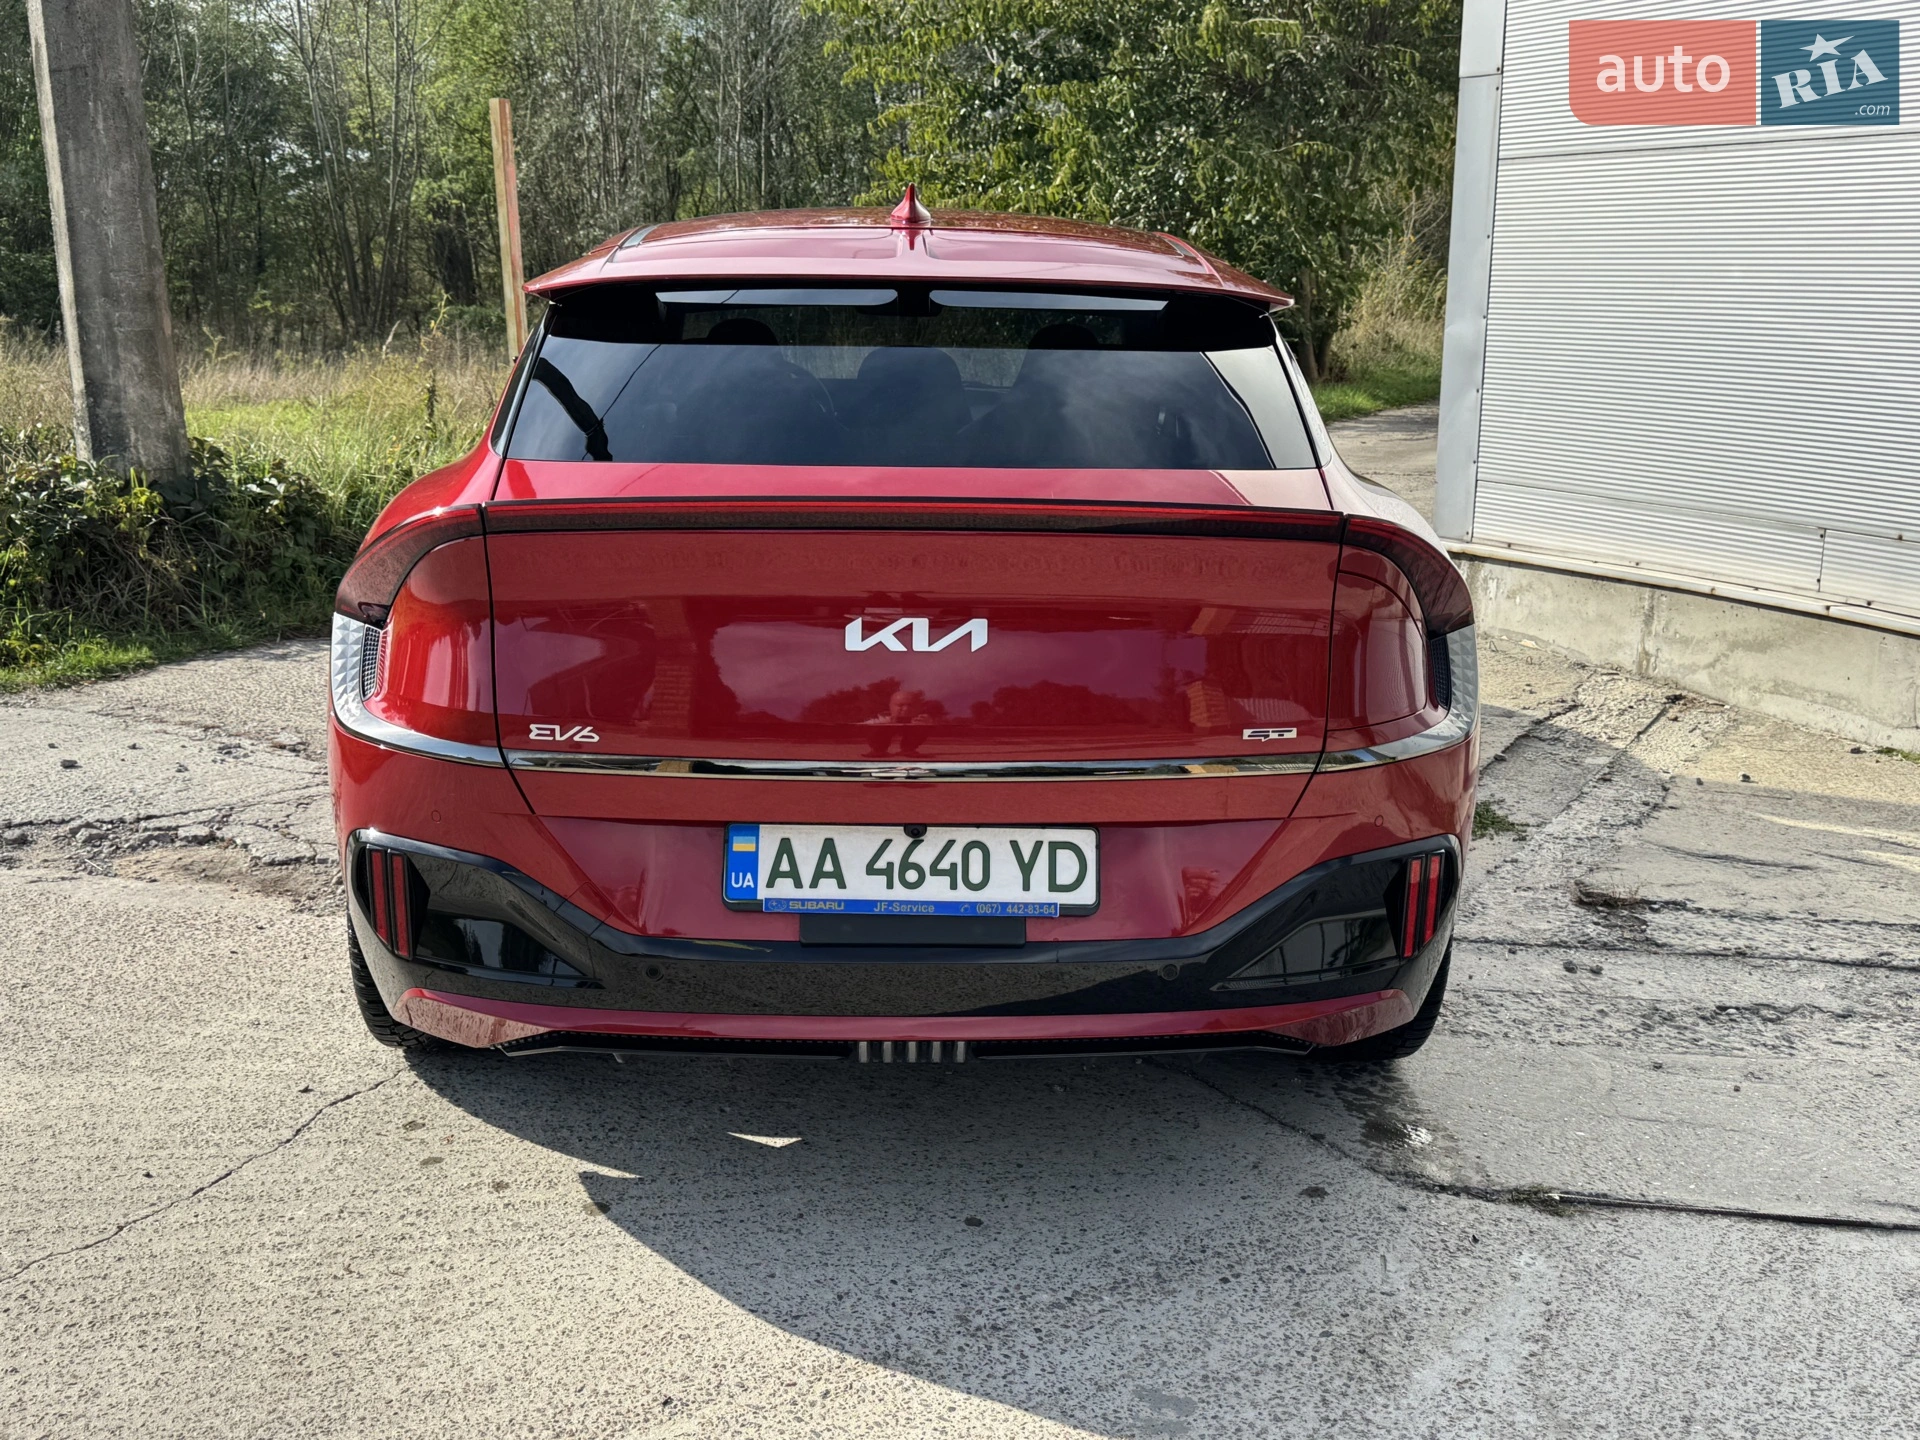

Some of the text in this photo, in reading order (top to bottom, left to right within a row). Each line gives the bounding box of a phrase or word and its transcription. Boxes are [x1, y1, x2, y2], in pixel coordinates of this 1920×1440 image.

[845, 617, 988, 652] KIA
[529, 723, 600, 743] EV6
[765, 837, 1088, 893] AA 4640 YD
[731, 873, 754, 889] UA
[789, 901, 1056, 915] SUBARU JF-Service (067) 442-83-64
